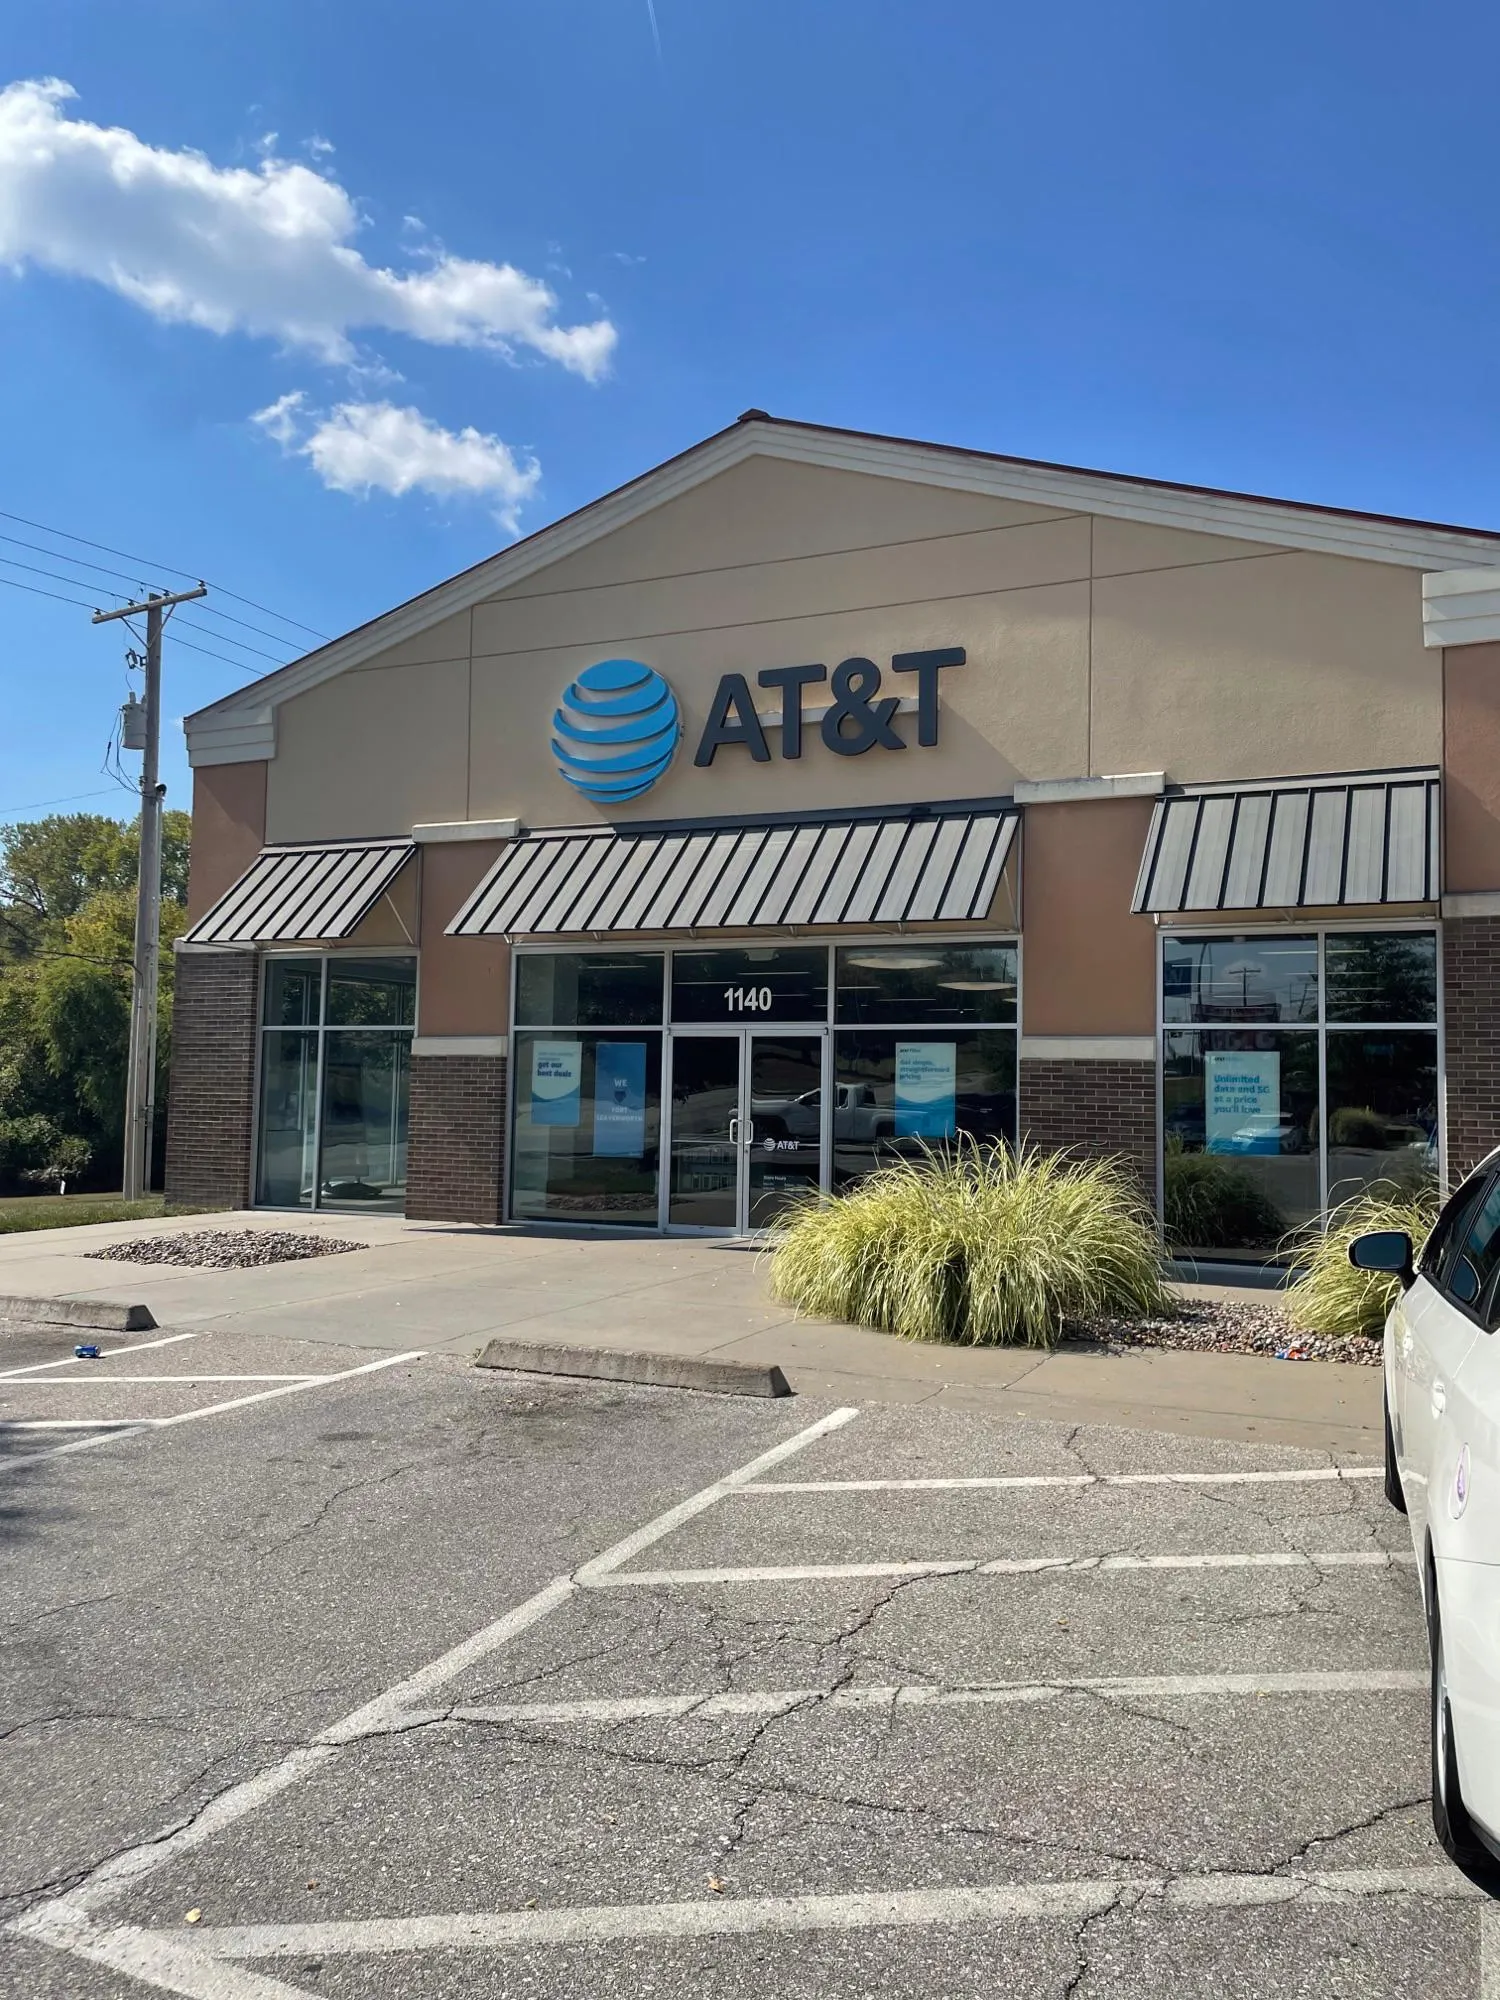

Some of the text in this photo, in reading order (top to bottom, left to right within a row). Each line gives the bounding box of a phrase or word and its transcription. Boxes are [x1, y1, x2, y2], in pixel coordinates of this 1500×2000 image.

[693, 646, 966, 767] AT&T
[724, 987, 772, 1011] 1140
[537, 1069, 552, 1077] best
[614, 1079, 628, 1087] WE
[1214, 1075, 1260, 1083] Unlimited
[1214, 1084, 1270, 1094] data and 5G
[1233, 1096, 1257, 1106] price
[1214, 1105, 1261, 1115] you'll love
[777, 1140, 800, 1150] AT&T
